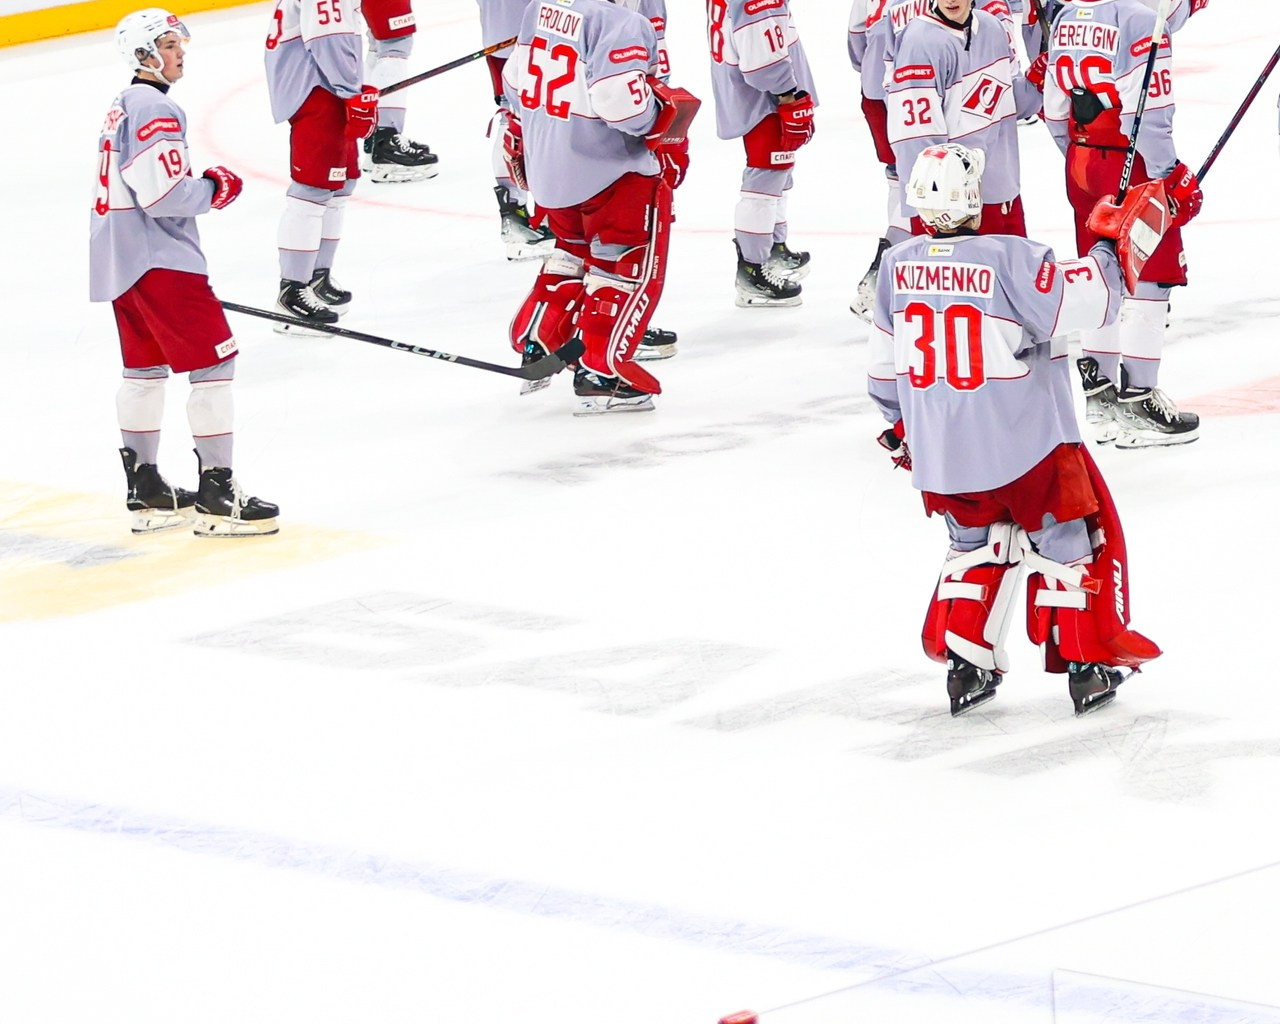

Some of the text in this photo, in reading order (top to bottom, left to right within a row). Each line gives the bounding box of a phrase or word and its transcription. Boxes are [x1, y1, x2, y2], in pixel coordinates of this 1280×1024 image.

[317, 0, 343, 25] 55
[539, 6, 581, 37] FROLOV
[764, 25, 785, 53] 18
[520, 36, 579, 120] 52
[1148, 69, 1172, 98] 96
[902, 97, 932, 127] 32
[158, 148, 183, 179] 19
[894, 265, 991, 295] KUZMENKO
[391, 340, 460, 363] CCM
[904, 302, 985, 390] 30
